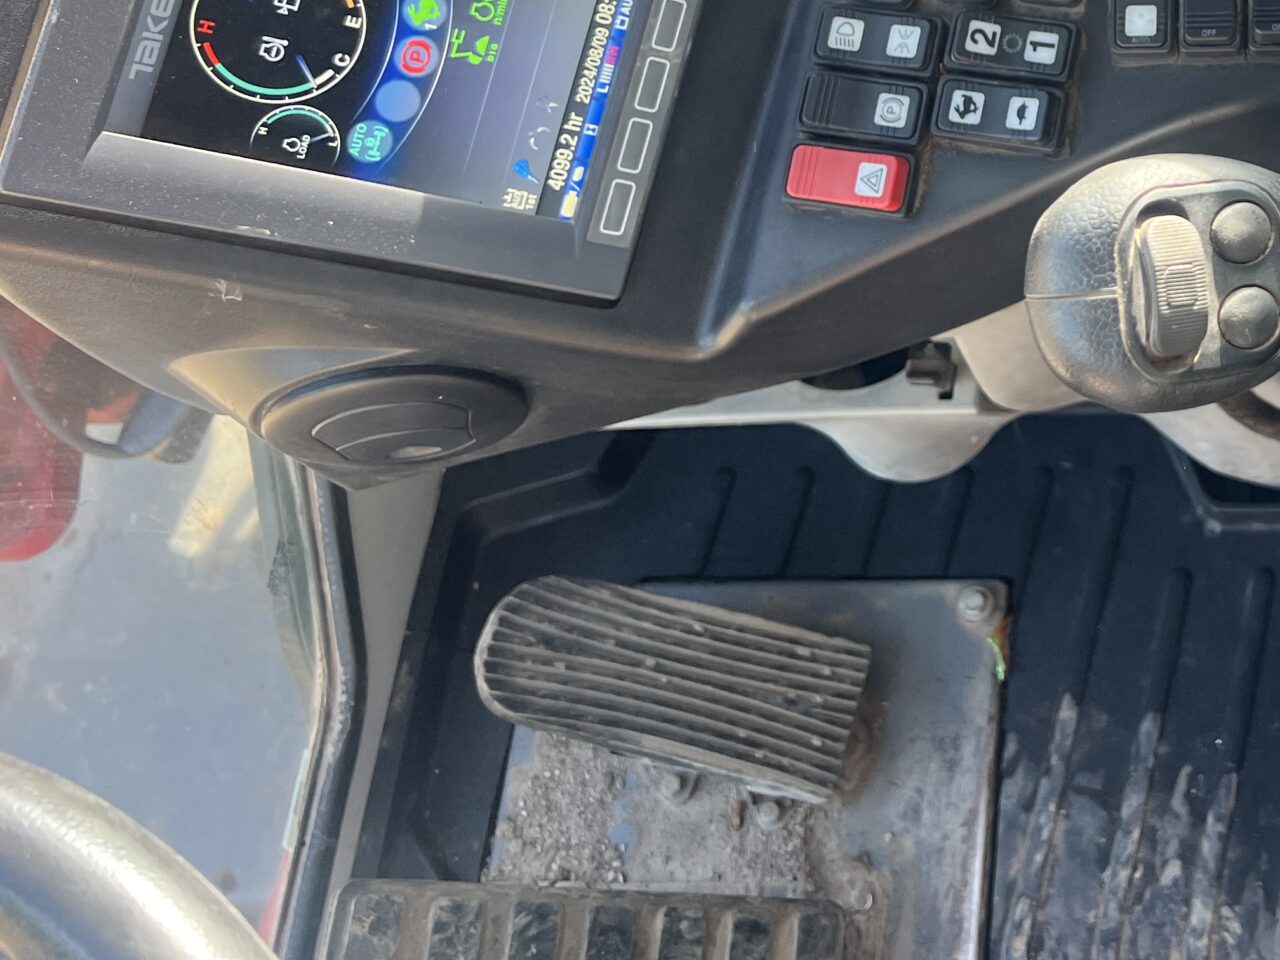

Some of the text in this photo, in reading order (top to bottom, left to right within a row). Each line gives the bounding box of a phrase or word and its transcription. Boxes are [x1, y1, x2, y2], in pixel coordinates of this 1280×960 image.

[197, 19, 216, 34] H
[344, 14, 363, 29] E
[969, 28, 998, 49] 2
[1201, 29, 1217, 37] OFF
[1028, 40, 1056, 52] 1
[332, 52, 351, 67] C
[546, 134, 578, 191] 4099.2
[563, 112, 584, 132] hr
[575, 26, 609, 104] 2024/08/09
[257, 126, 269, 136] H
[296, 134, 311, 159] LOAD
[349, 123, 367, 157] AUTO
